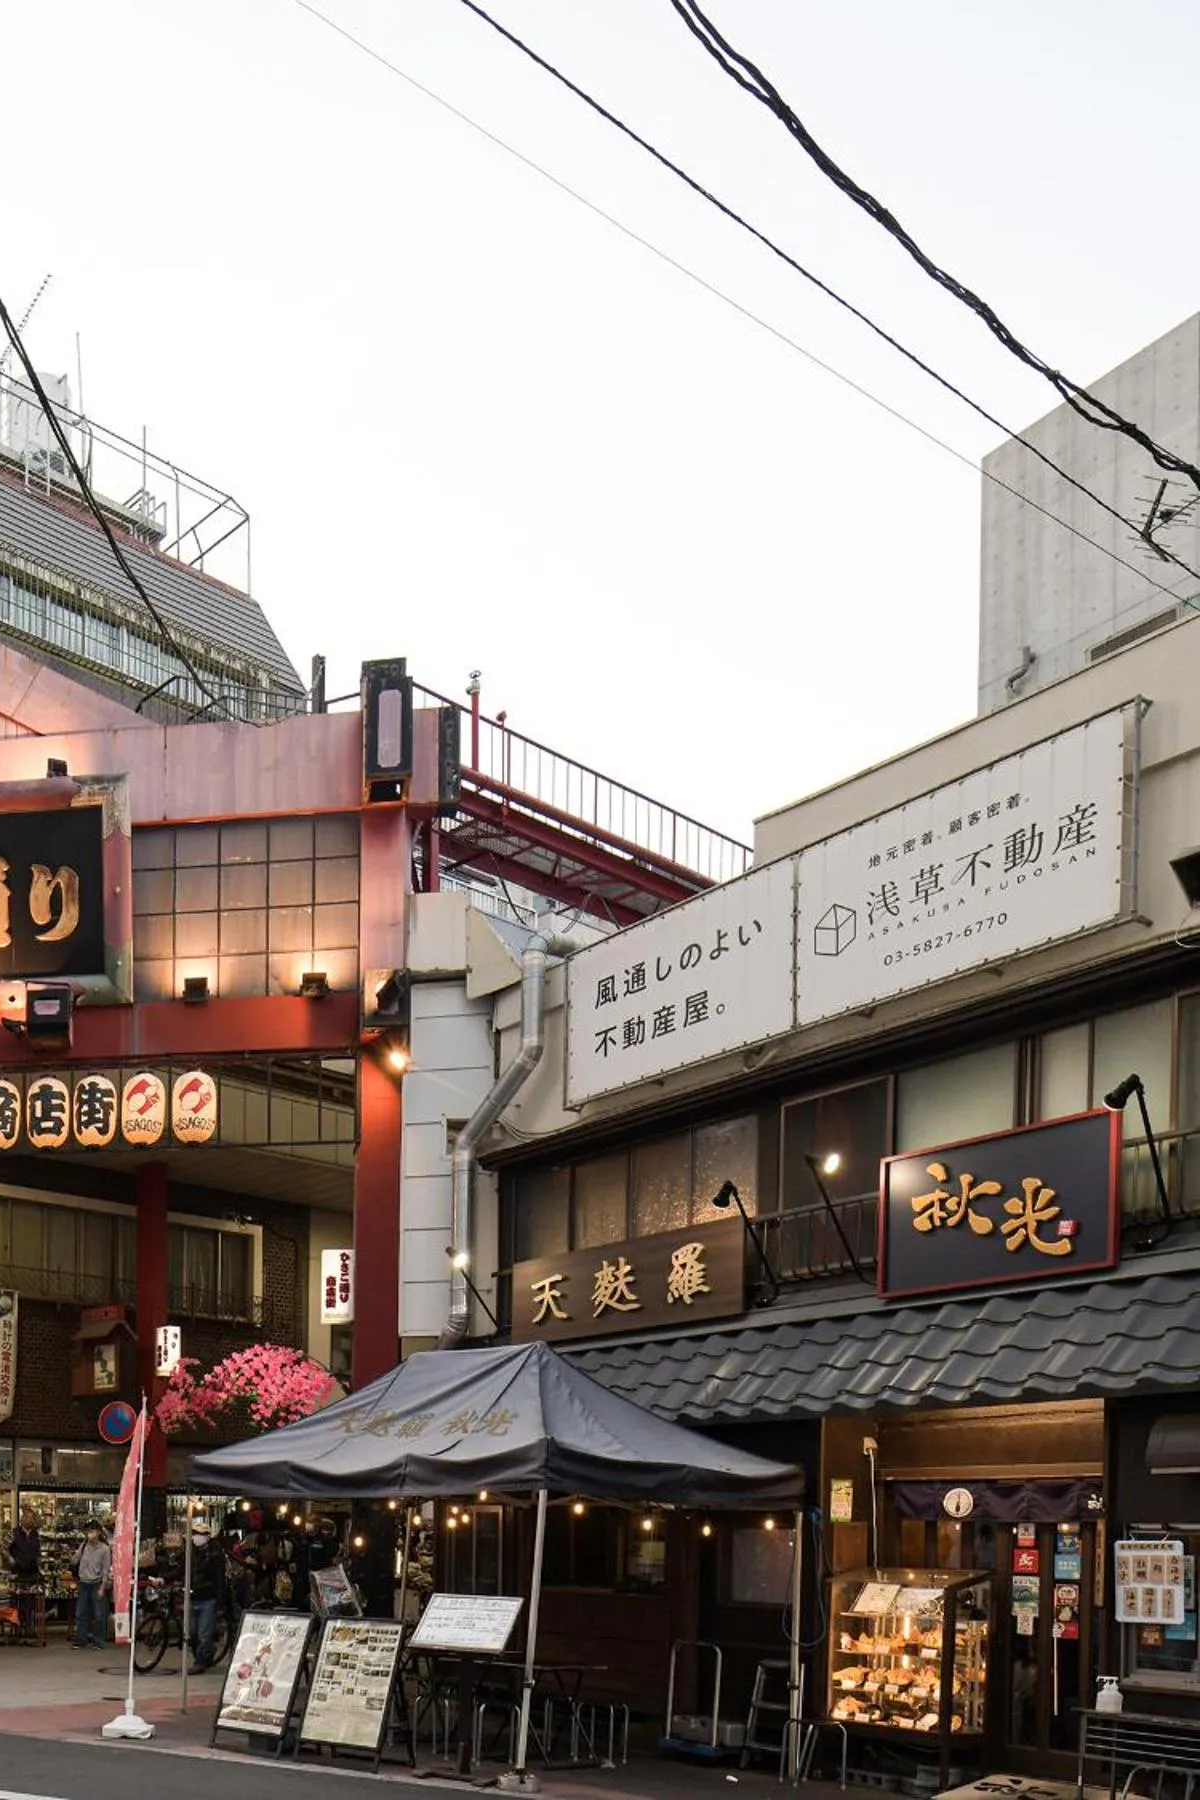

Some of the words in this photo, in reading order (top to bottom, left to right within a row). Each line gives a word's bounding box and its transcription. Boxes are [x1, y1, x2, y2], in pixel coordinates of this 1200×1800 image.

[866, 803, 1098, 926] 浅草不動産
[867, 898, 966, 941] ASAKUSA
[984, 847, 1097, 896] FUDOSAN
[595, 919, 762, 1010] 風通しのよい
[883, 912, 1008, 967] 03-5827-6770
[595, 990, 726, 1057] 不動産屋。
[912, 1162, 1073, 1257] 秋光
